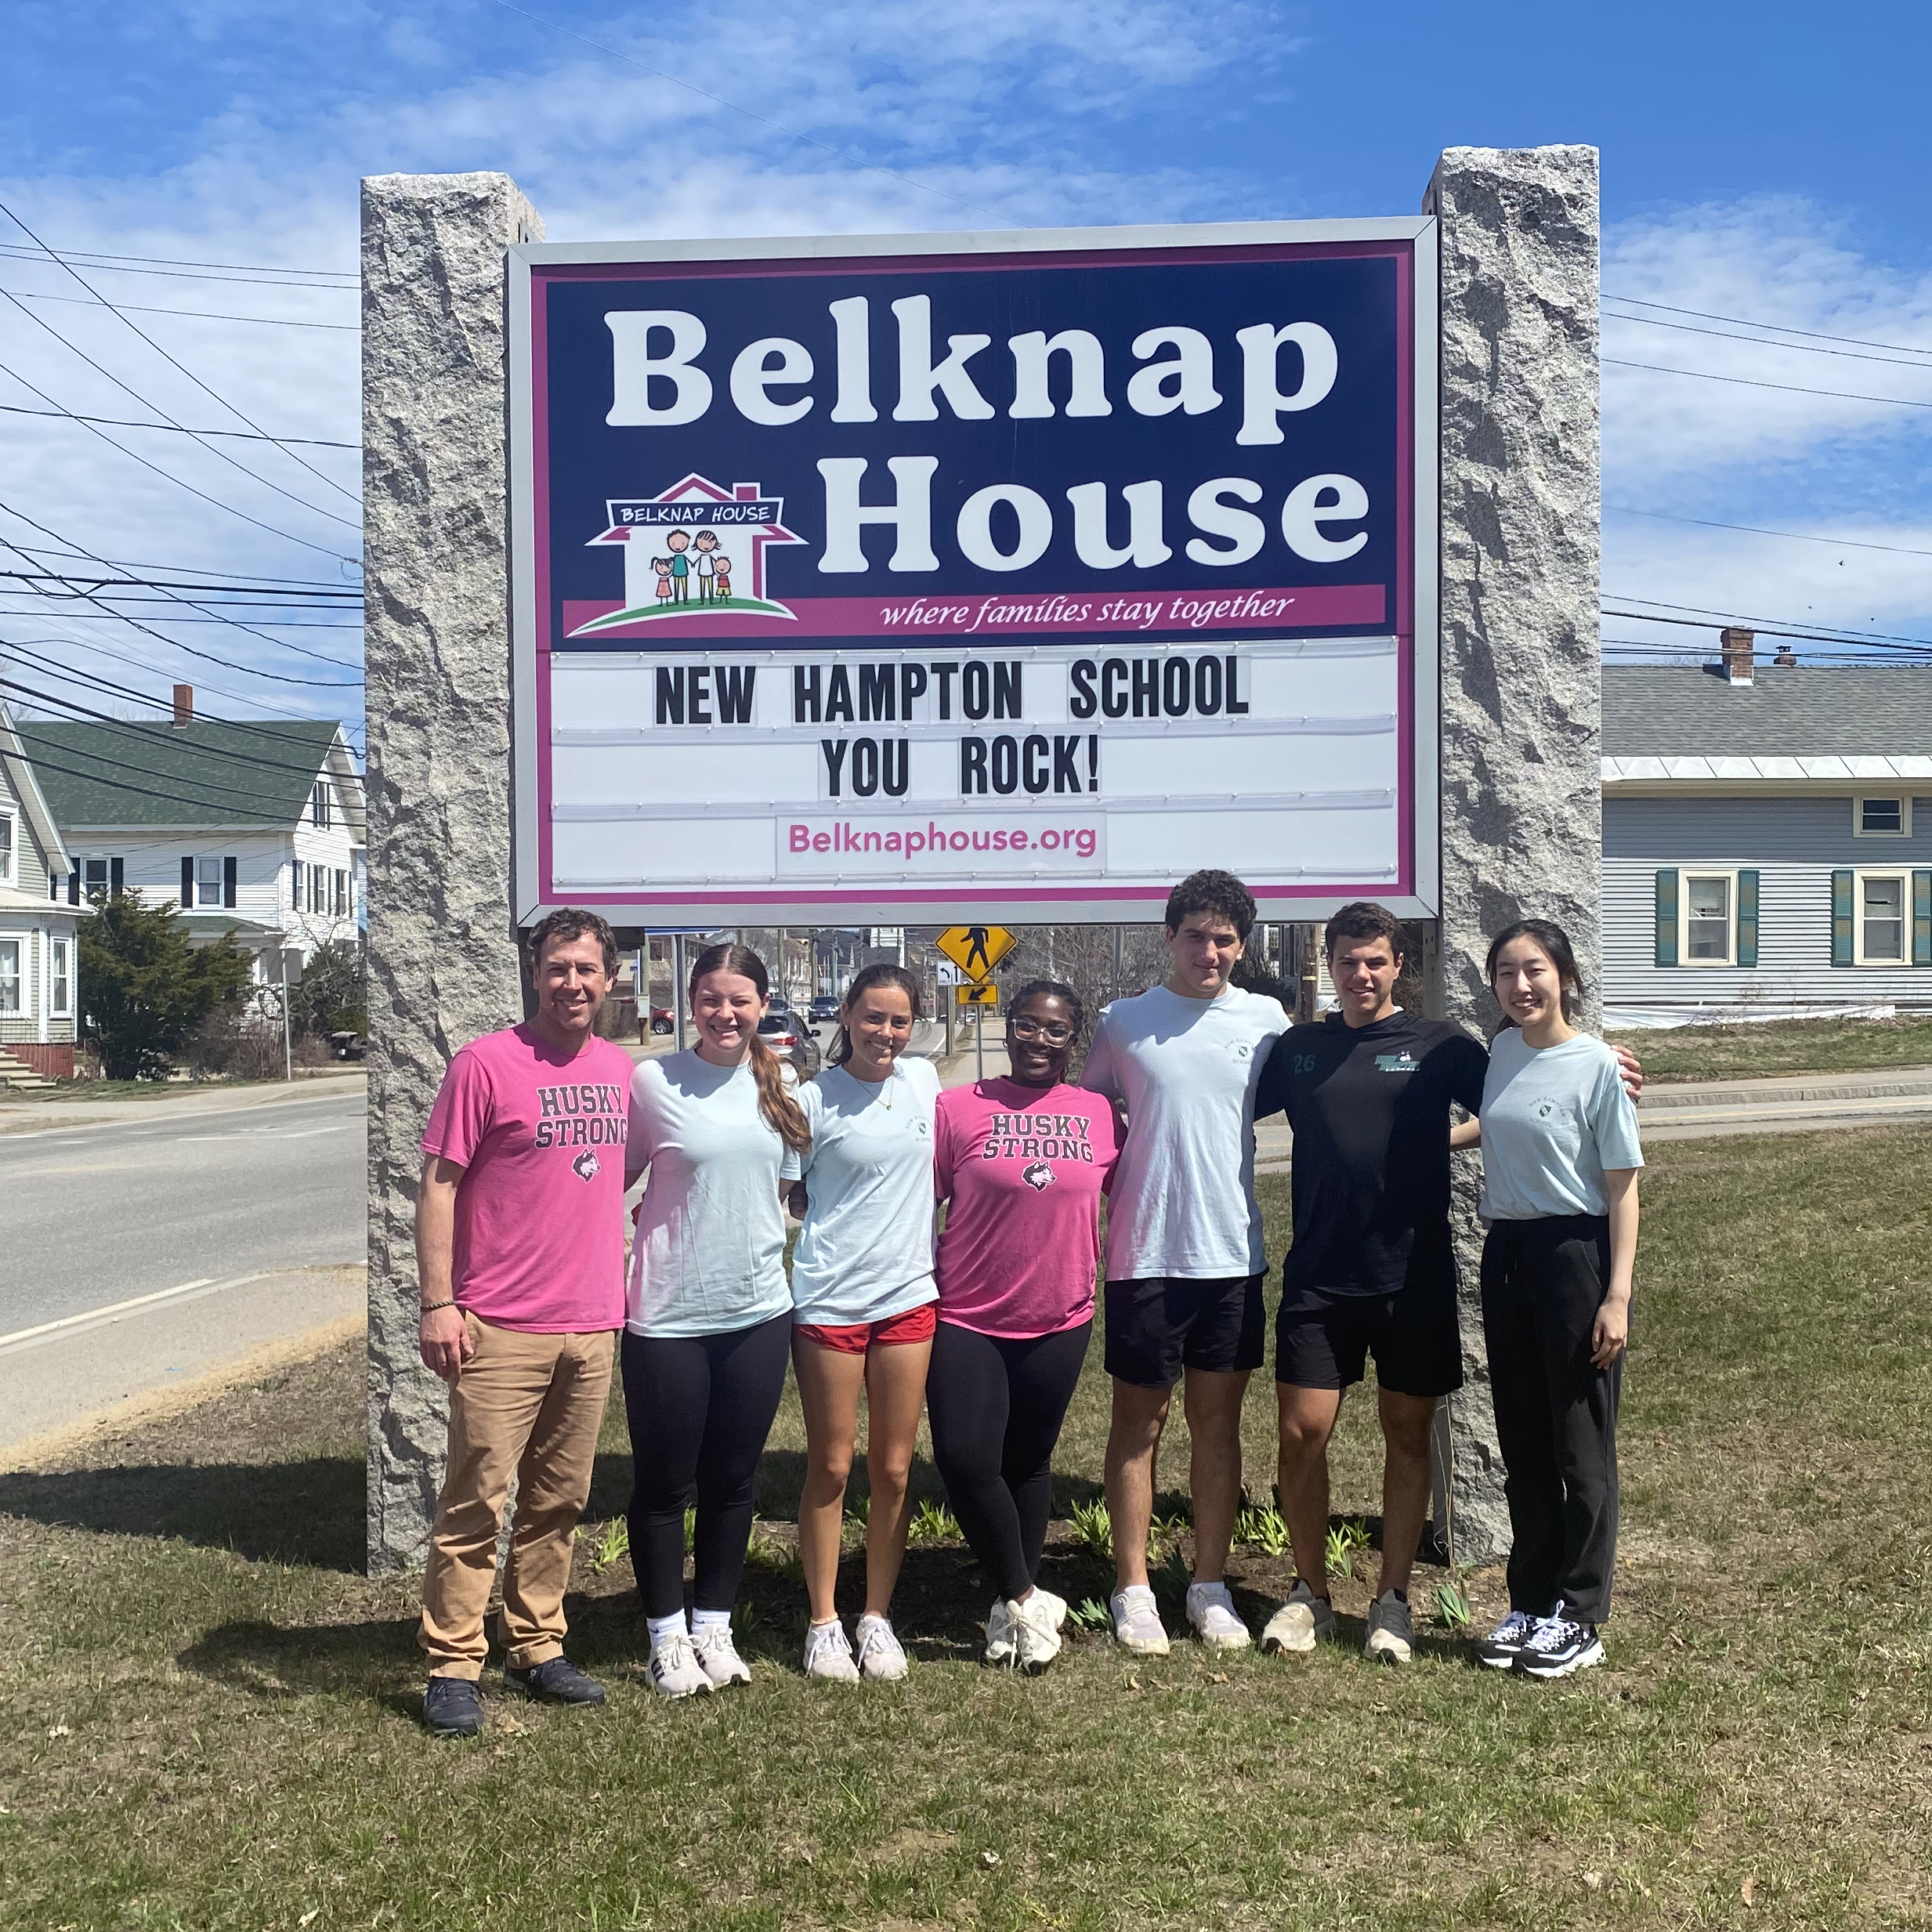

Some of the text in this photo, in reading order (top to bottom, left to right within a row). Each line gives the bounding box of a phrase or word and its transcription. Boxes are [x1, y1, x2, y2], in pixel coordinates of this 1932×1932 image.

[604, 295, 1337, 446] Belknap
[620, 506, 771, 523] BELKNAP HOUSE
[816, 456, 1369, 573] House
[880, 590, 1296, 633] where families stay together
[656, 655, 1249, 725] NEW HAMPTON SCHOOL
[820, 734, 1098, 797] YOU ROCK!
[790, 822, 1096, 859] Belknaphouse.org
[1293, 1054, 1316, 1074] 26
[536, 1084, 624, 1118] HUSKY
[1543, 1096, 1566, 1117] HAMPTON
[534, 1116, 628, 1149] STRONG
[991, 1113, 1091, 1141] HUSKY
[1529, 1116, 1553, 1128] SCHOOL
[982, 1137, 1094, 1164] STRONG
